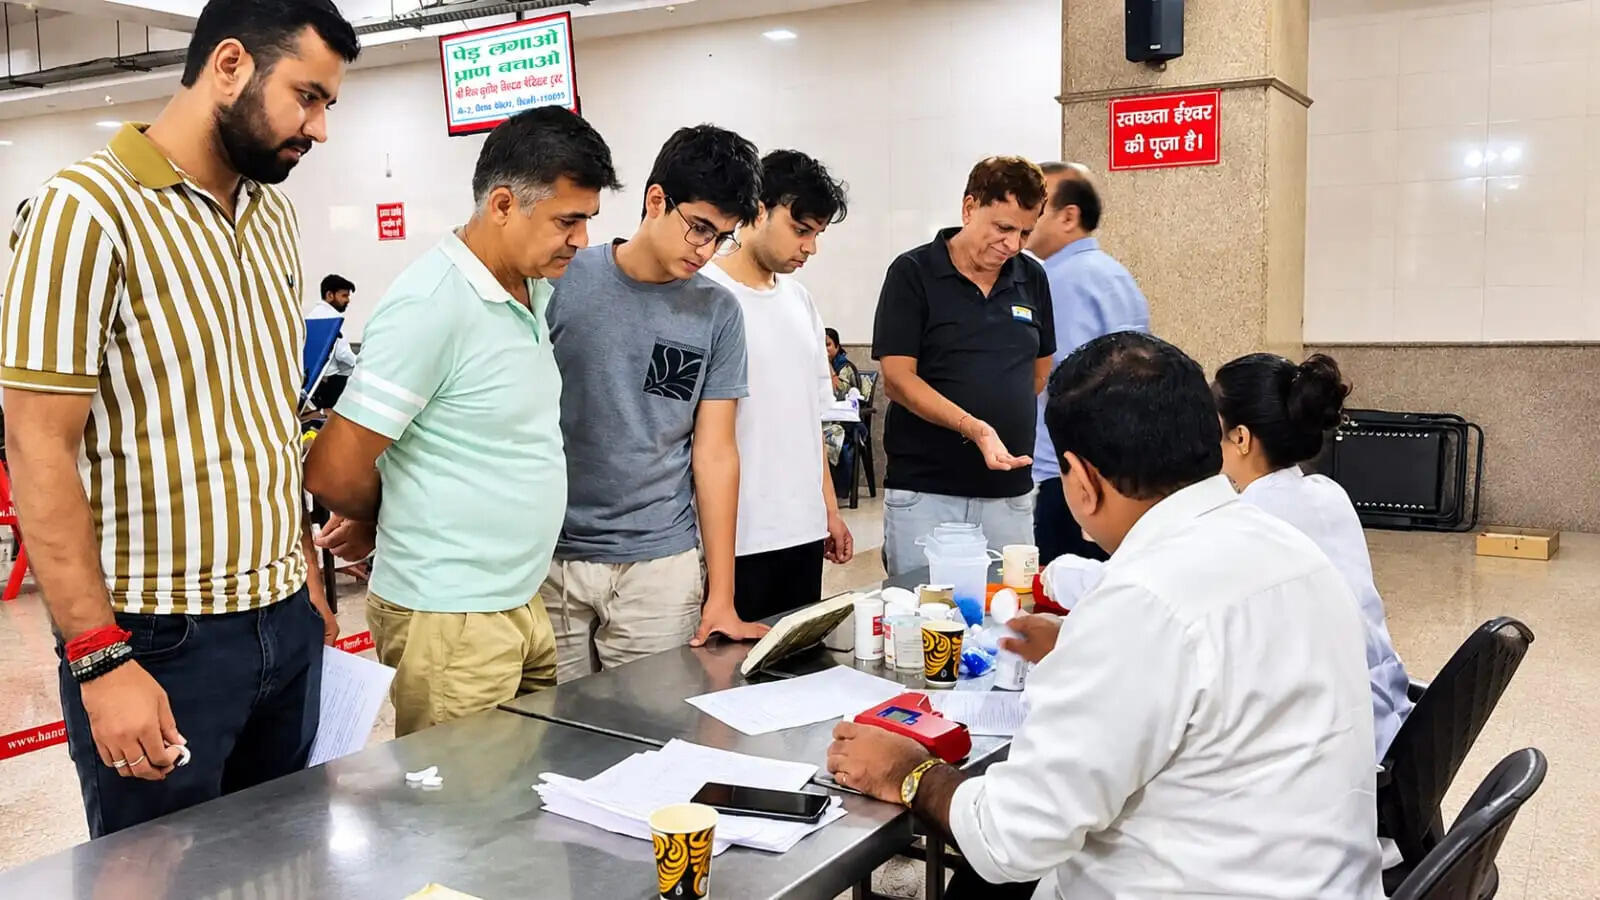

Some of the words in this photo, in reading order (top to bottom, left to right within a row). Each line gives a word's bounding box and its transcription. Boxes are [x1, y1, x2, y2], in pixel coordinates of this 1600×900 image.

[453, 46, 481, 64] पेड़
[488, 29, 558, 56] लगाओ
[454, 65, 491, 87] प्राण
[498, 51, 560, 73] बचाओ
[1116, 108, 1170, 128] स्वच्छता
[1173, 101, 1214, 125] ईश्वर
[1124, 133, 1145, 153] की
[1149, 136, 1181, 159] पूजा
[8, 728, 66, 750] www.hanu
